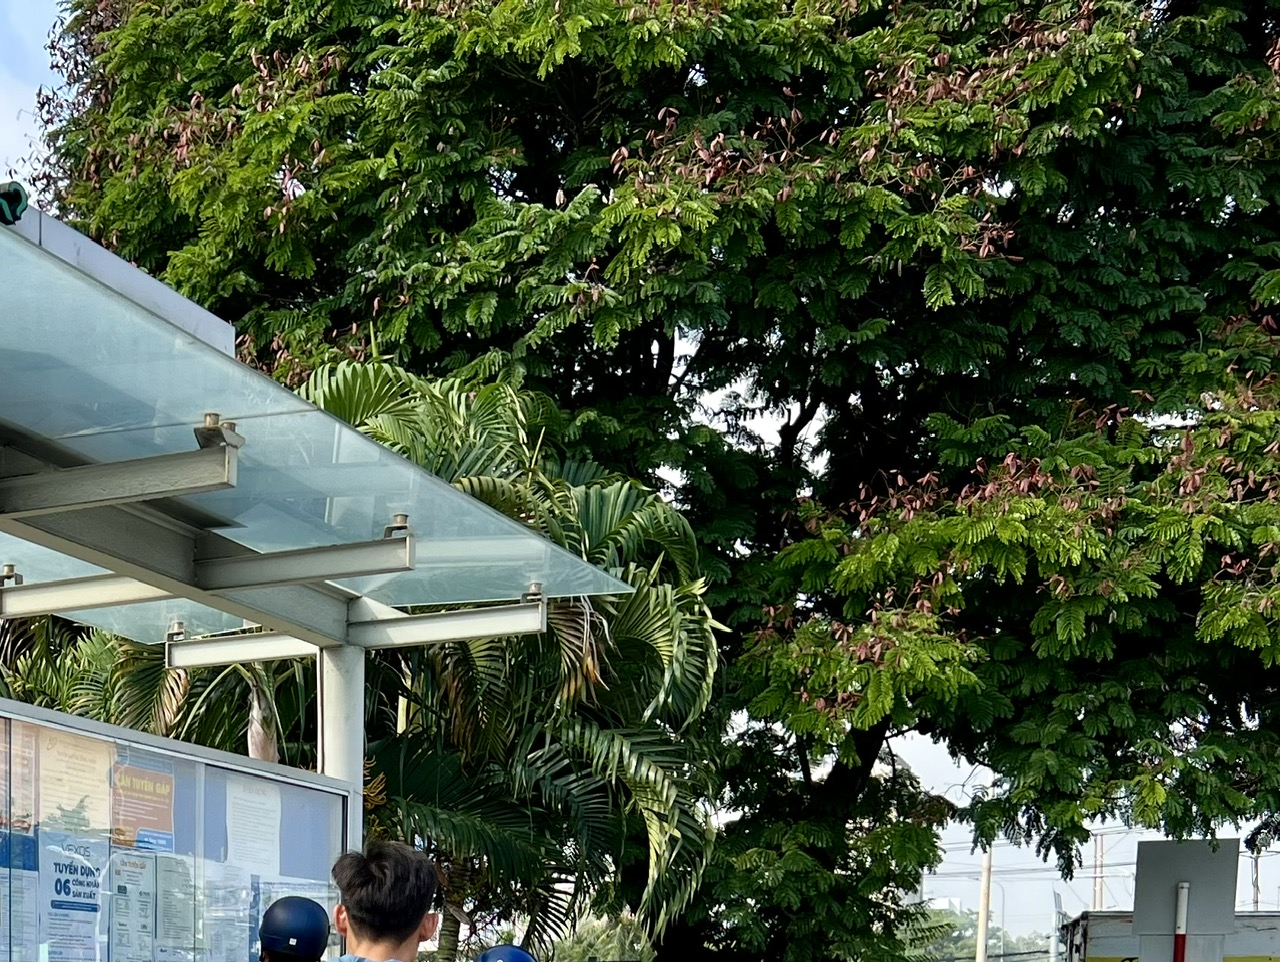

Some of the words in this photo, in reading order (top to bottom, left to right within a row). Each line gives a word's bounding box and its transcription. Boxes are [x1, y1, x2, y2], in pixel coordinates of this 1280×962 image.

[53, 860, 79, 877] TUYỂN
[80, 866, 101, 879] DỤNG
[54, 878, 71, 896] 06
